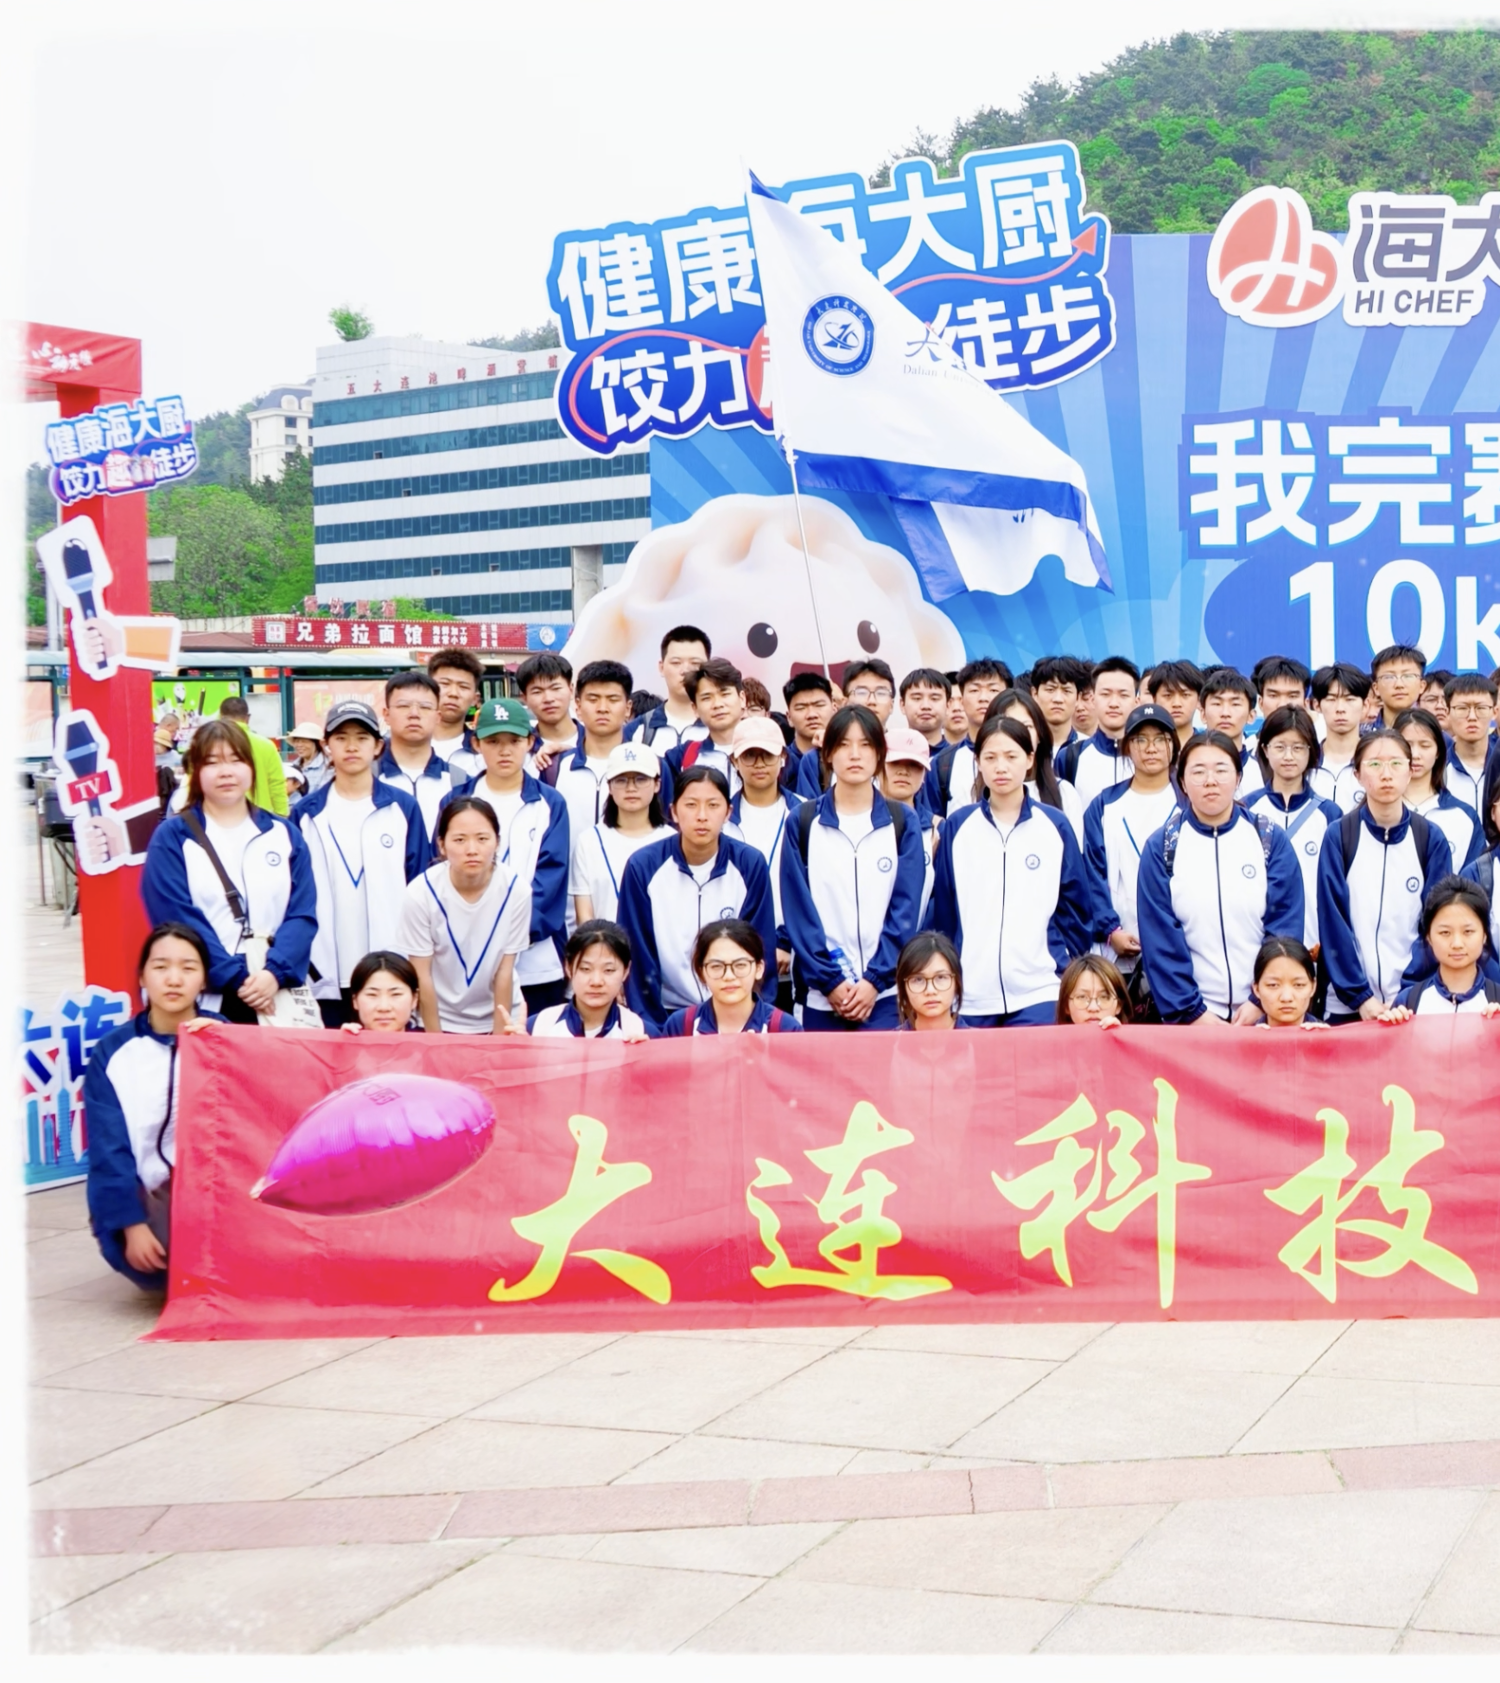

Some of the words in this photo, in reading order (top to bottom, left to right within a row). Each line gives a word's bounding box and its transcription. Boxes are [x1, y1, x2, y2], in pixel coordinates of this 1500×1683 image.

[1355, 290, 1384, 313] HI
[1394, 290, 1475, 313] CHEF
[47, 399, 187, 464] 健康海大厨
[296, 622, 423, 645] 兄弟拉面馆
[75, 777, 101, 799] TV
